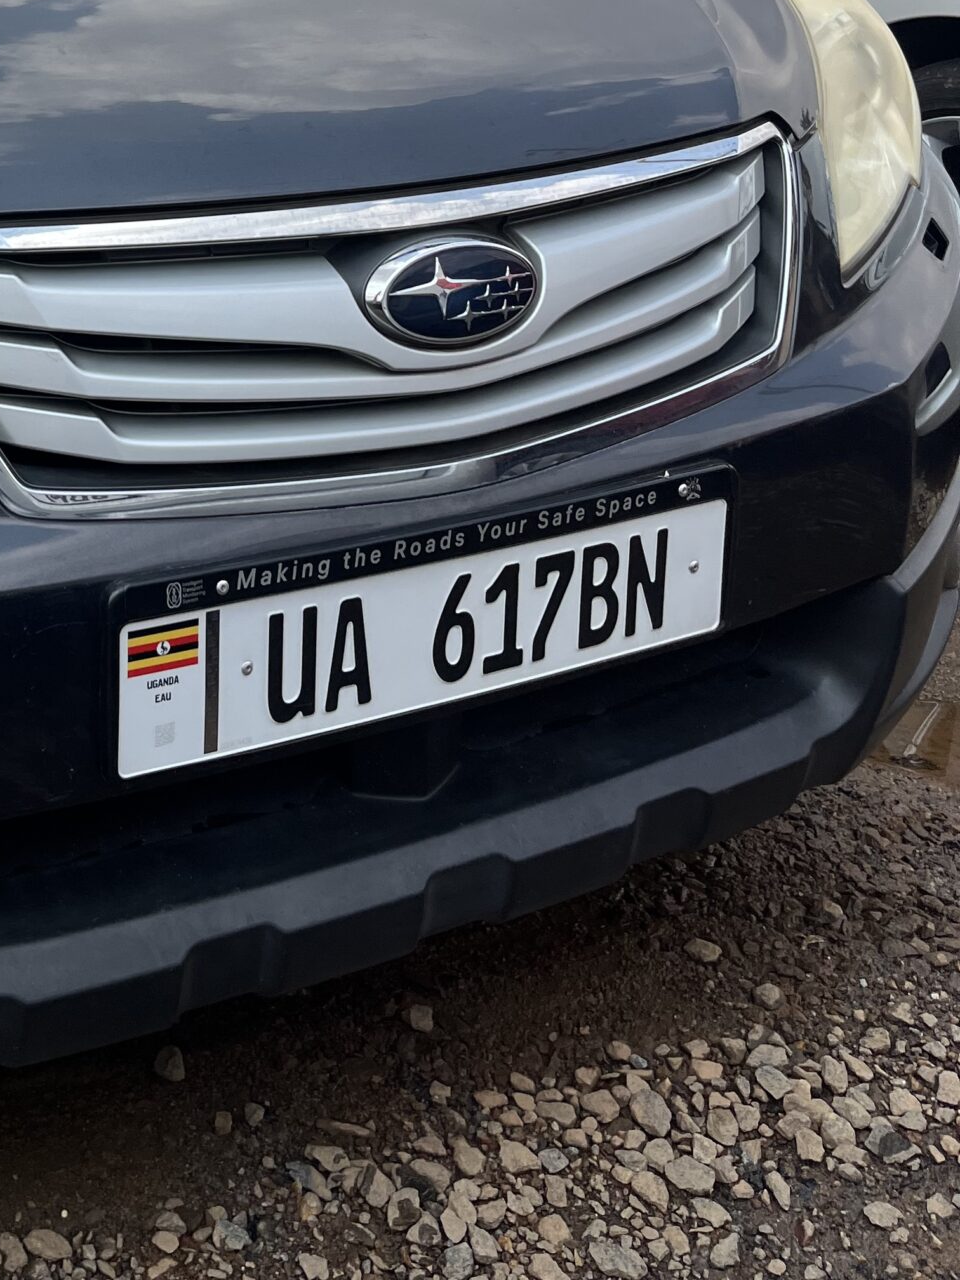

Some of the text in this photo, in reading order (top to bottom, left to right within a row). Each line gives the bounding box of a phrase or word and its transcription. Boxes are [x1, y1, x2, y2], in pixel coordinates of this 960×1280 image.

[236, 491, 658, 591] Making the Roads Your Safe Space
[266, 527, 670, 724] UA 617BN
[146, 675, 180, 690] UGANDA
[154, 692, 172, 704] EAU
